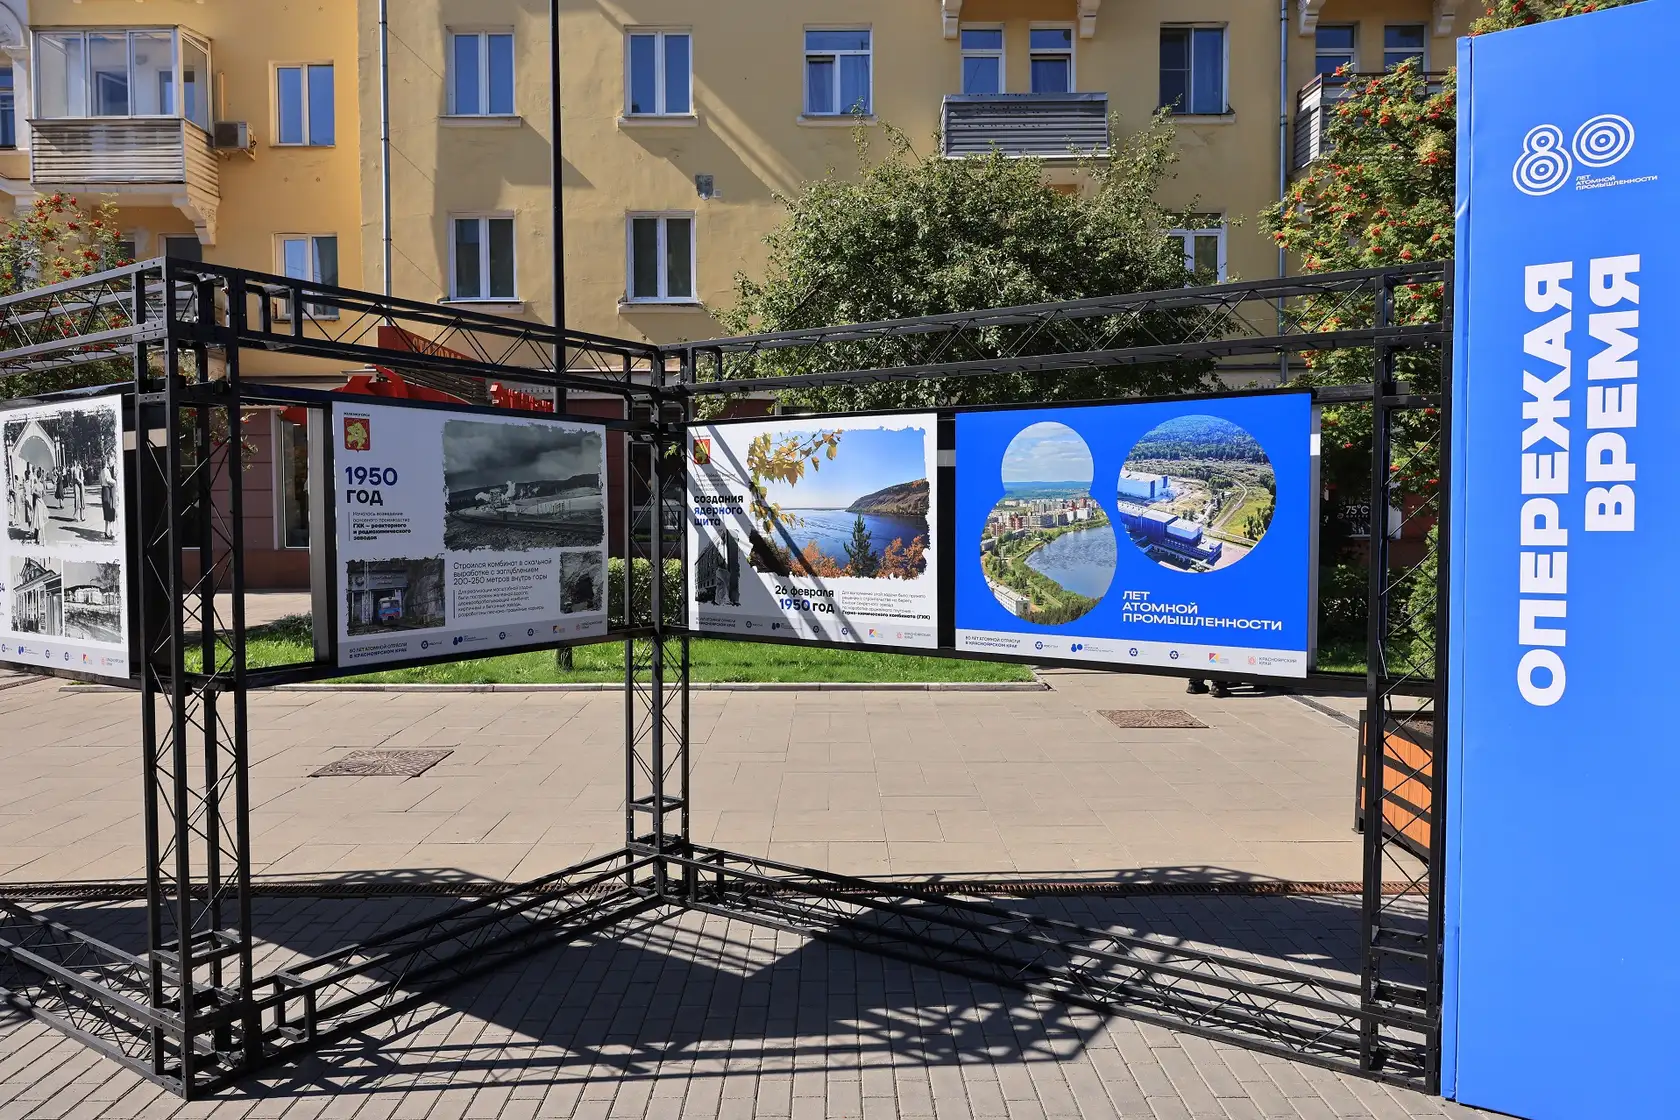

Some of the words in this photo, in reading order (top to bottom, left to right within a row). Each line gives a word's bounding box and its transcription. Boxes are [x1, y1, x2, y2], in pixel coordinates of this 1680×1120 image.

[1575, 175, 1616, 186] АТОМНОЙ
[1575, 175, 1658, 191] ПРОМЫШЛЕННОСТИ
[1584, 253, 1640, 532] ВРЕМЯ
[345, 466, 398, 486] 1950
[1517, 260, 1573, 707] ОПЕРЕЖАЯ
[347, 489, 384, 506] ГОД
[693, 494, 744, 505] создания
[693, 507, 743, 518] ядерного
[693, 517, 721, 528] щита
[453, 561, 486, 571] Строился
[487, 560, 517, 569] комбинат
[453, 570, 489, 579] выработке
[496, 567, 539, 576] заглублением
[453, 576, 485, 586] 200-250
[486, 576, 510, 584] метров
[775, 585, 788, 595] 26
[789, 585, 835, 598] февраля
[1122, 590, 1150, 602] ЛЕТ
[779, 598, 811, 612] 1950
[812, 602, 835, 614] год
[1122, 600, 1198, 615] АТОМНОЙ
[1122, 613, 1283, 631] ПРОМЫШЛЕННОСТИ
